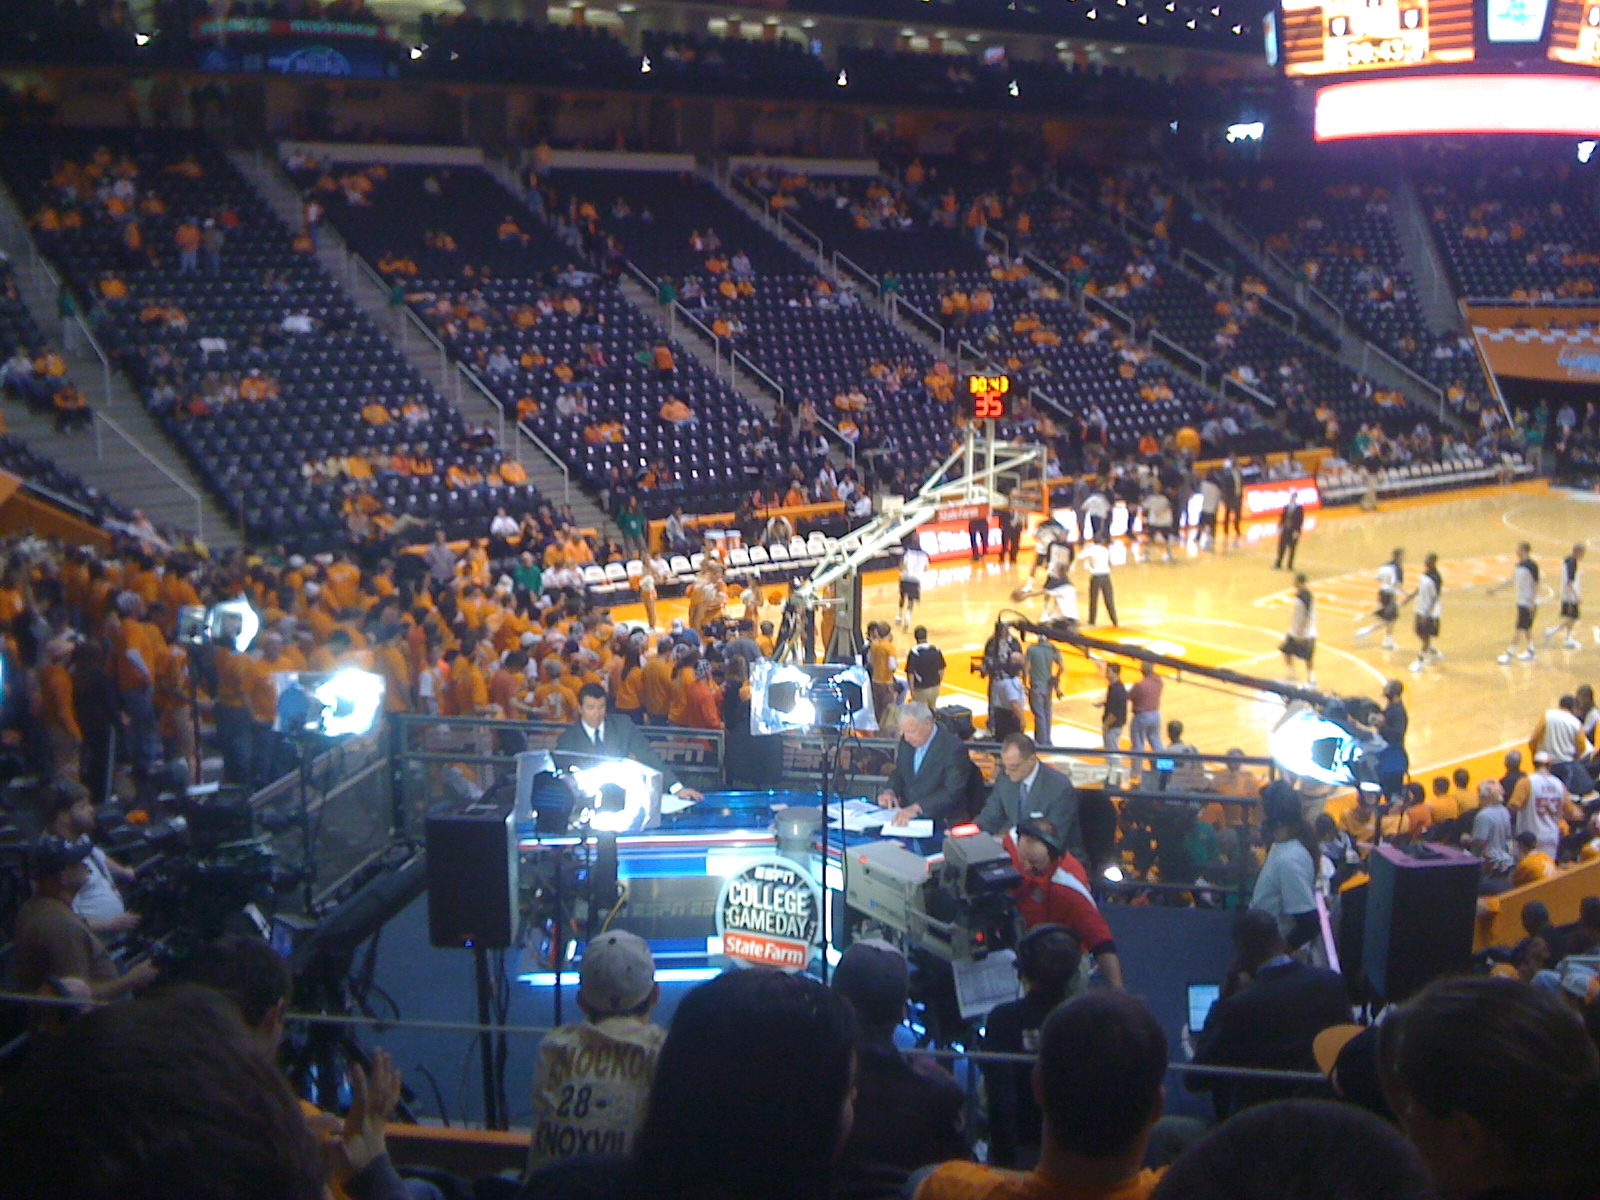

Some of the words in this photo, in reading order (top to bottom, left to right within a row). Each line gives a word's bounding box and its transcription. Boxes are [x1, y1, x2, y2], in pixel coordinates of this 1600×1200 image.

[975, 391, 1004, 418] 35
[754, 866, 795, 884] ESPN
[728, 880, 809, 917] COLLEGE
[727, 905, 808, 939] GAMEDAY
[726, 936, 764, 958] State
[763, 942, 804, 965] Farm
